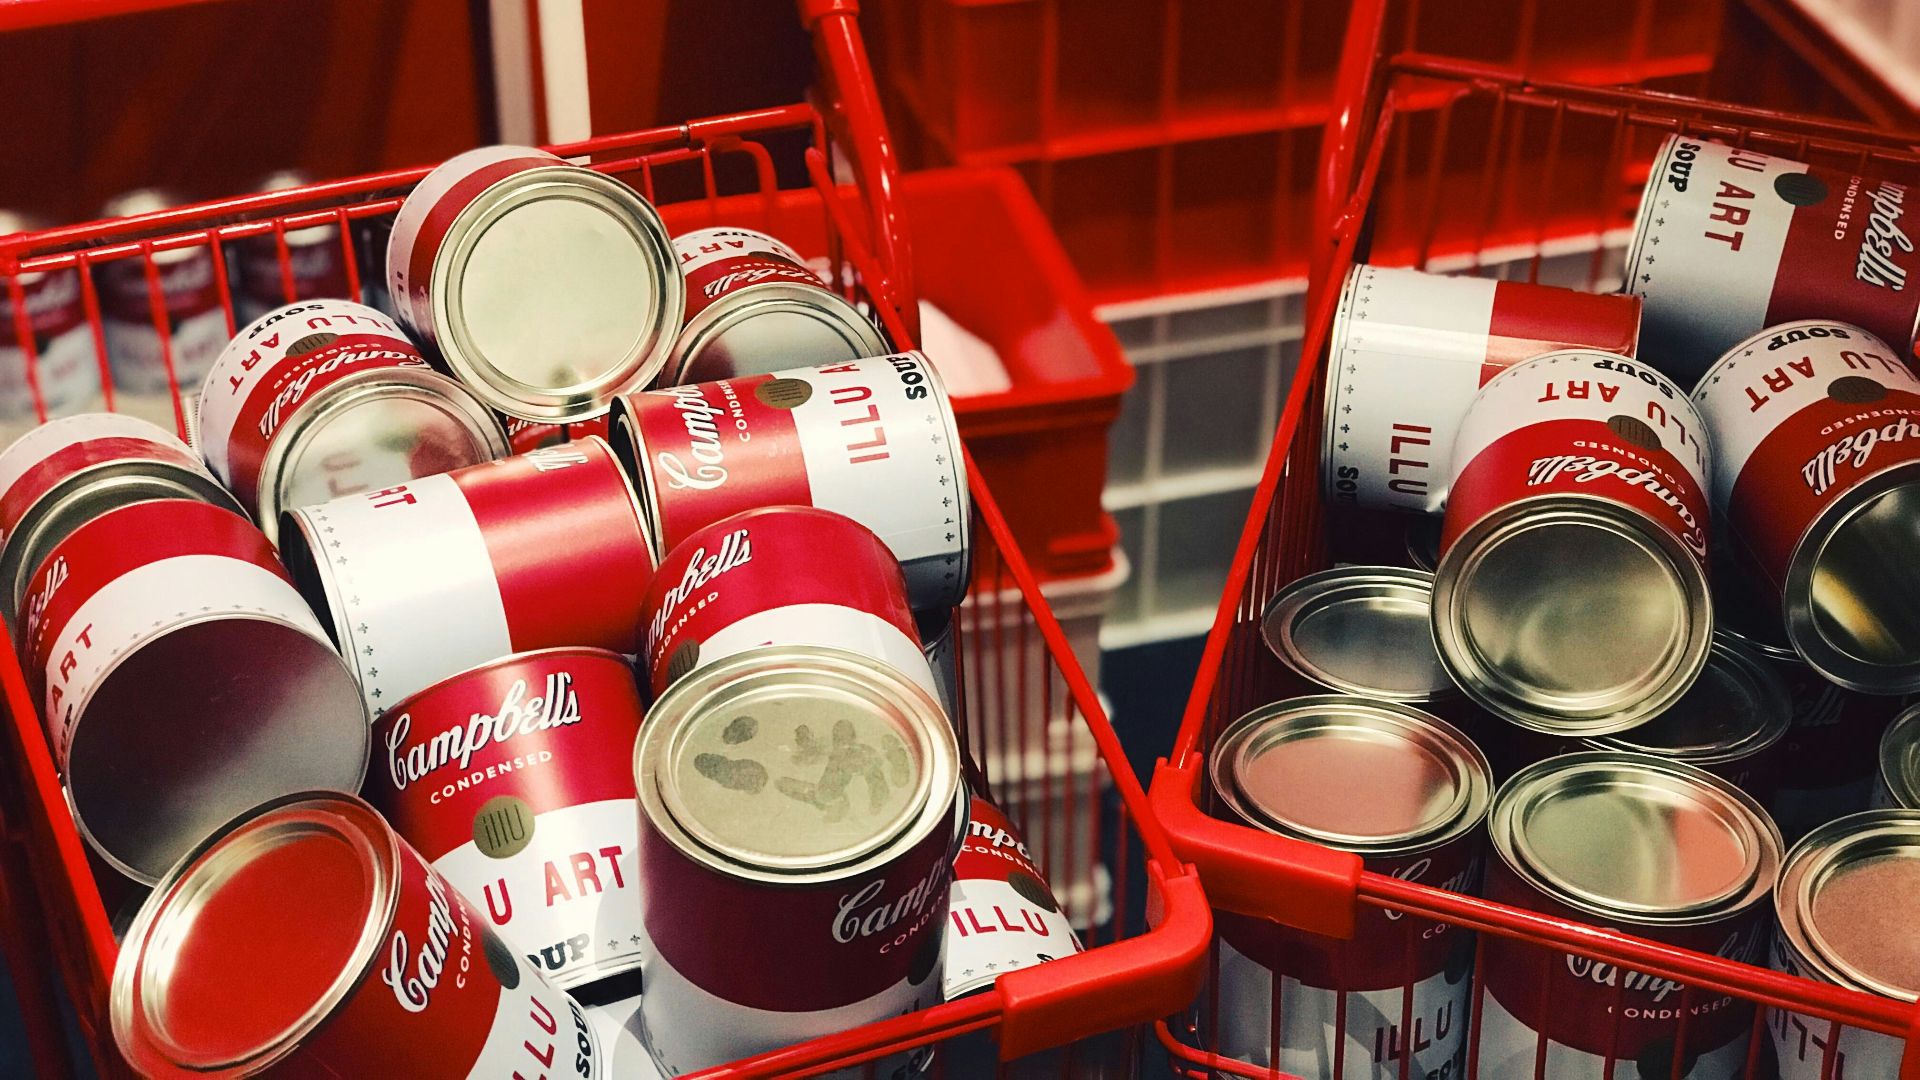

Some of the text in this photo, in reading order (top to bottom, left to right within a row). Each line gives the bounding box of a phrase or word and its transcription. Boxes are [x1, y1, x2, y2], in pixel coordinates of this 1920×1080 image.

[1668, 142, 1701, 192] SOUP
[1705, 180, 1755, 252] ART
[1835, 175, 1863, 240] ONDENSED
[1856, 180, 1914, 291] mpbell's
[681, 240, 744, 265] ART
[248, 304, 325, 339] SOUP
[1767, 327, 1851, 351] SOUP
[229, 332, 279, 395] ART
[273, 343, 382, 389] CONDENSED
[1537, 380, 1620, 403] ART
[1593, 358, 1674, 400] SOUP
[1744, 356, 1815, 413] ART
[715, 379, 750, 442] CONDENS
[830, 385, 890, 464] ILLU
[1820, 408, 1920, 435] ONDENSED
[1387, 423, 1432, 495] ILLU
[1573, 440, 1686, 495] CONDENSED
[646, 529, 752, 657] mpbell's
[653, 591, 719, 672] ONDENSED
[51, 622, 93, 714] ART
[385, 671, 582, 791] Campbell's
[430, 750, 553, 805] CONDENSED
[544, 845, 625, 907] ART
[950, 905, 1050, 937] ILLU
[1375, 1000, 1453, 1063] ILLU
